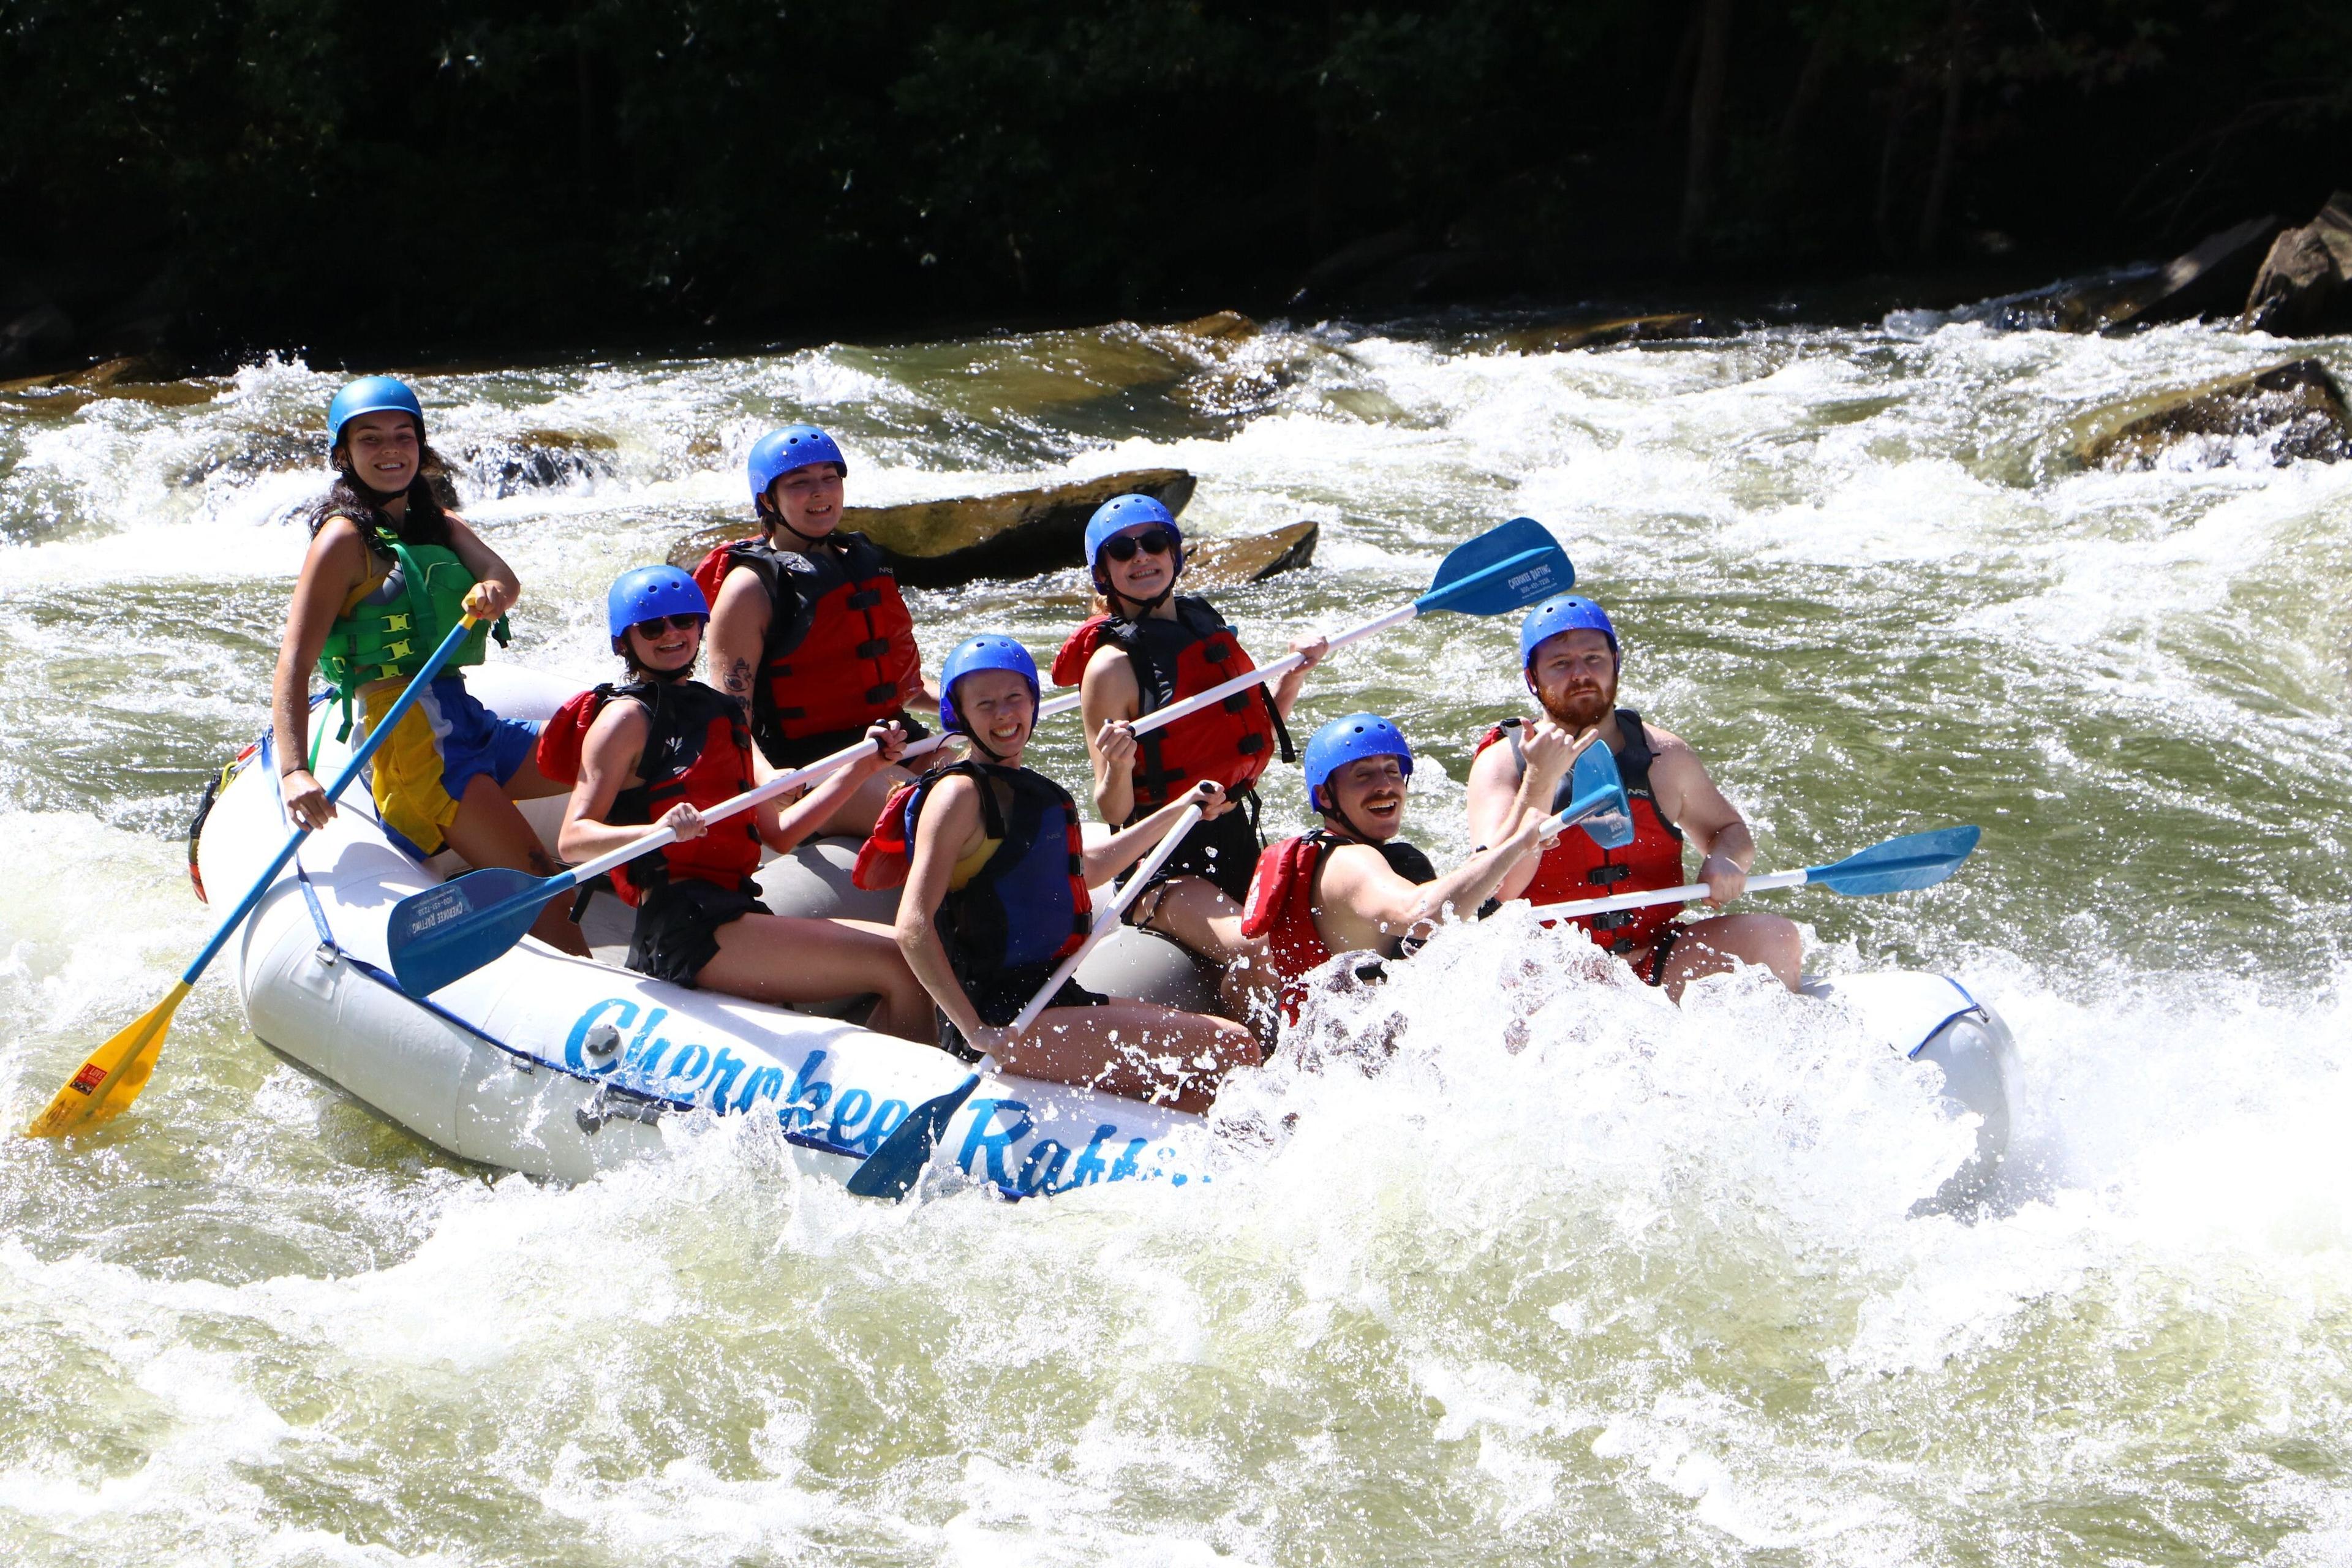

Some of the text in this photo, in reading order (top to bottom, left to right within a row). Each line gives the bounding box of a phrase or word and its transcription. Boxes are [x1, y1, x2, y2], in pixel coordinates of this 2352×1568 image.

[1529, 564, 1551, 581] RAFTING
[412, 901, 463, 933] CHEROKEE RAFTING
[565, 998, 910, 1155] Cherokee
